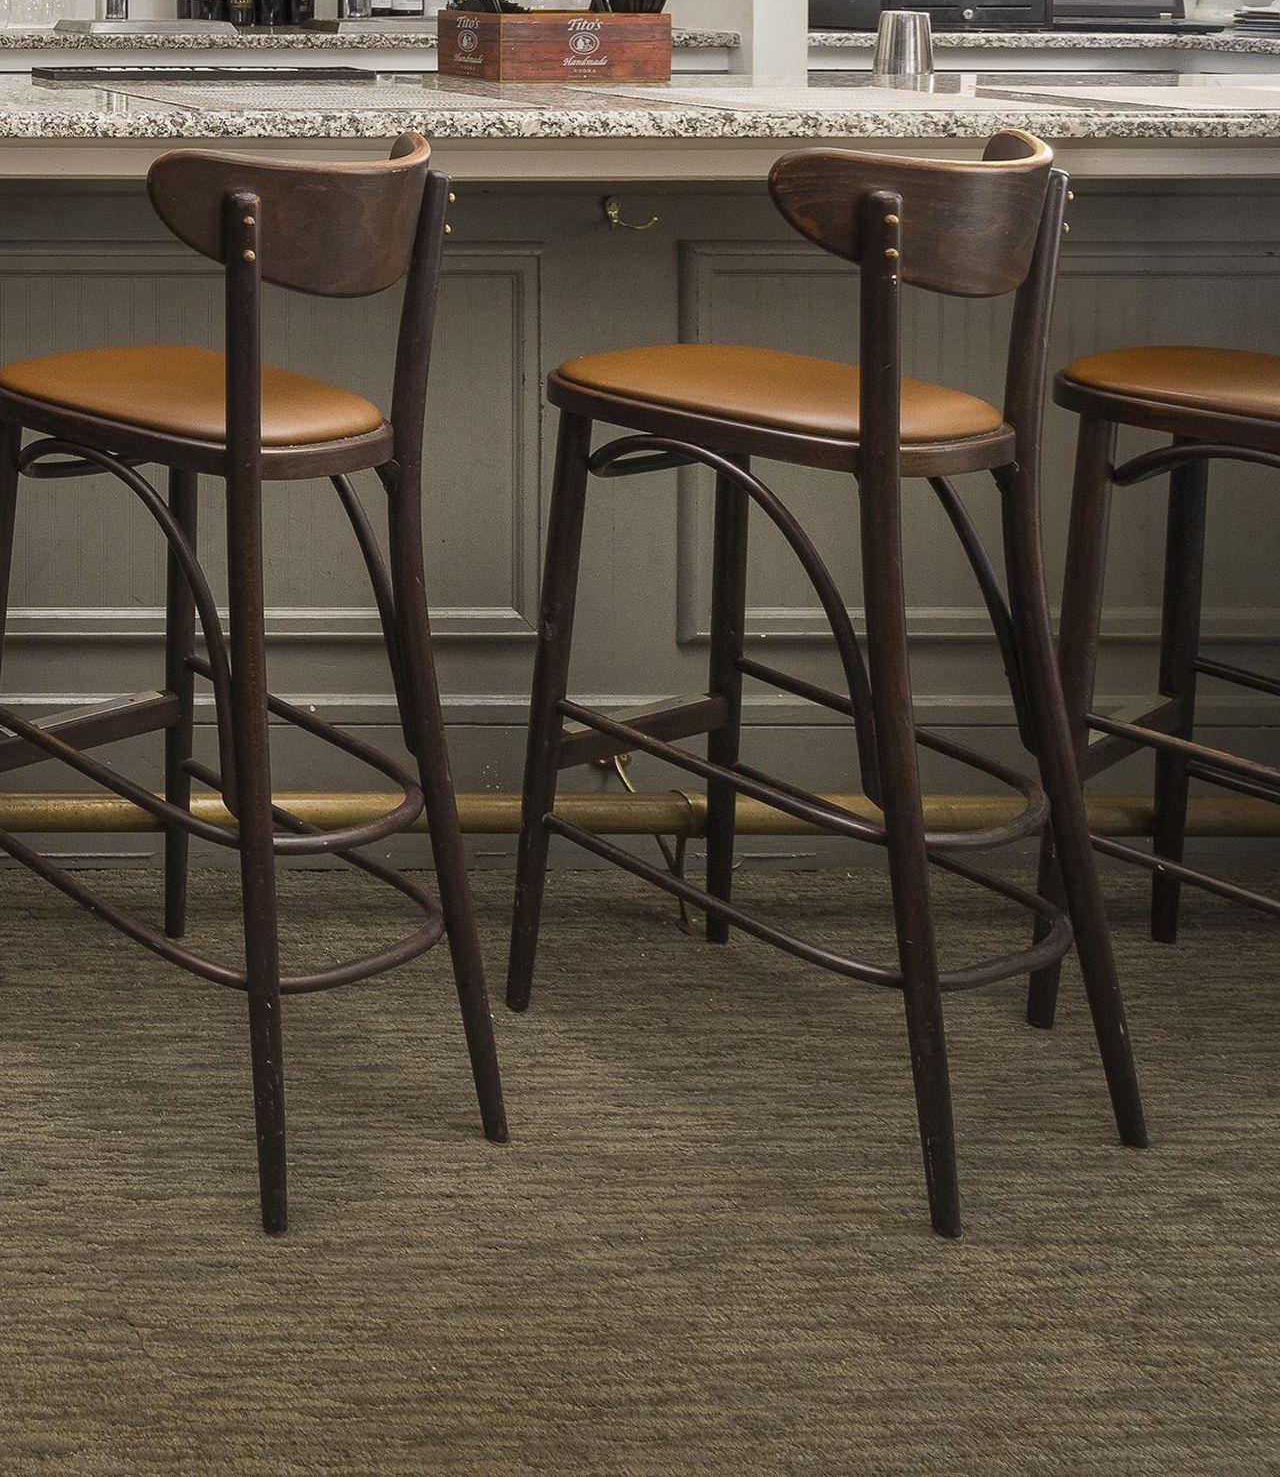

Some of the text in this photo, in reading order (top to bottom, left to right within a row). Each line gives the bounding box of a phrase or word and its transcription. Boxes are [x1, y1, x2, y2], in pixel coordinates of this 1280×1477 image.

[456, 16, 481, 29] Tito's
[566, 18, 604, 31] Tito's
[562, 55, 609, 67] Handmade
